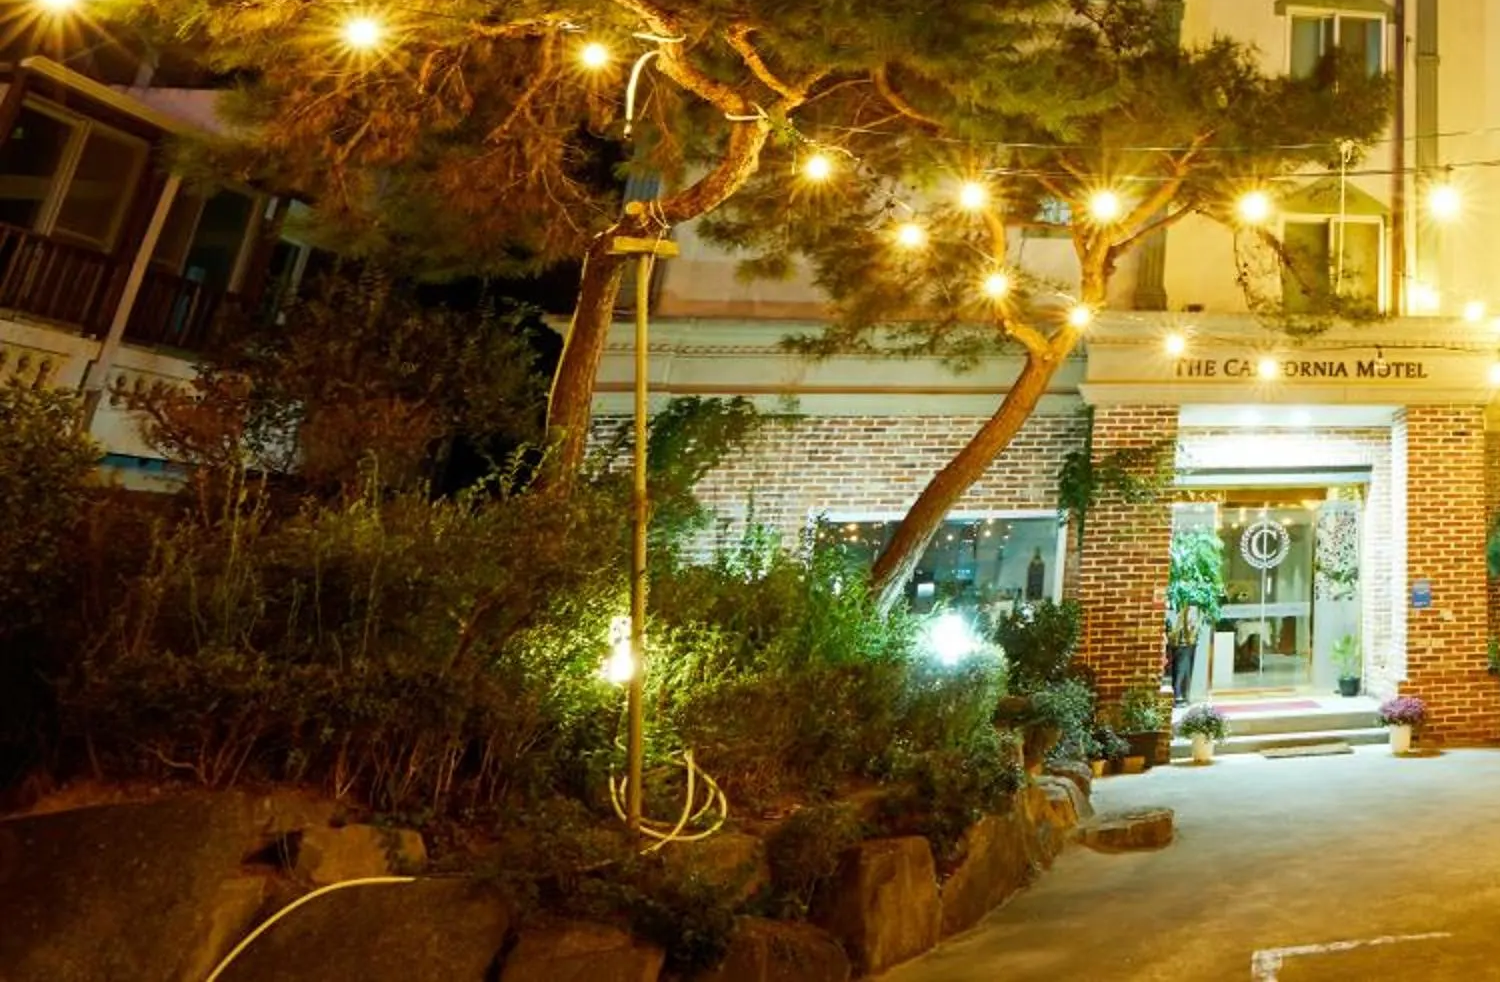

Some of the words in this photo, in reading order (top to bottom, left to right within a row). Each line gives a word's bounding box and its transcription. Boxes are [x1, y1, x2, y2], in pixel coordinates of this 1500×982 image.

[1175, 358, 1217, 377] THE
[1223, 358, 1349, 378] CAORNIA
[1356, 360, 1429, 379] MOTEL
[1251, 529, 1278, 559] C
